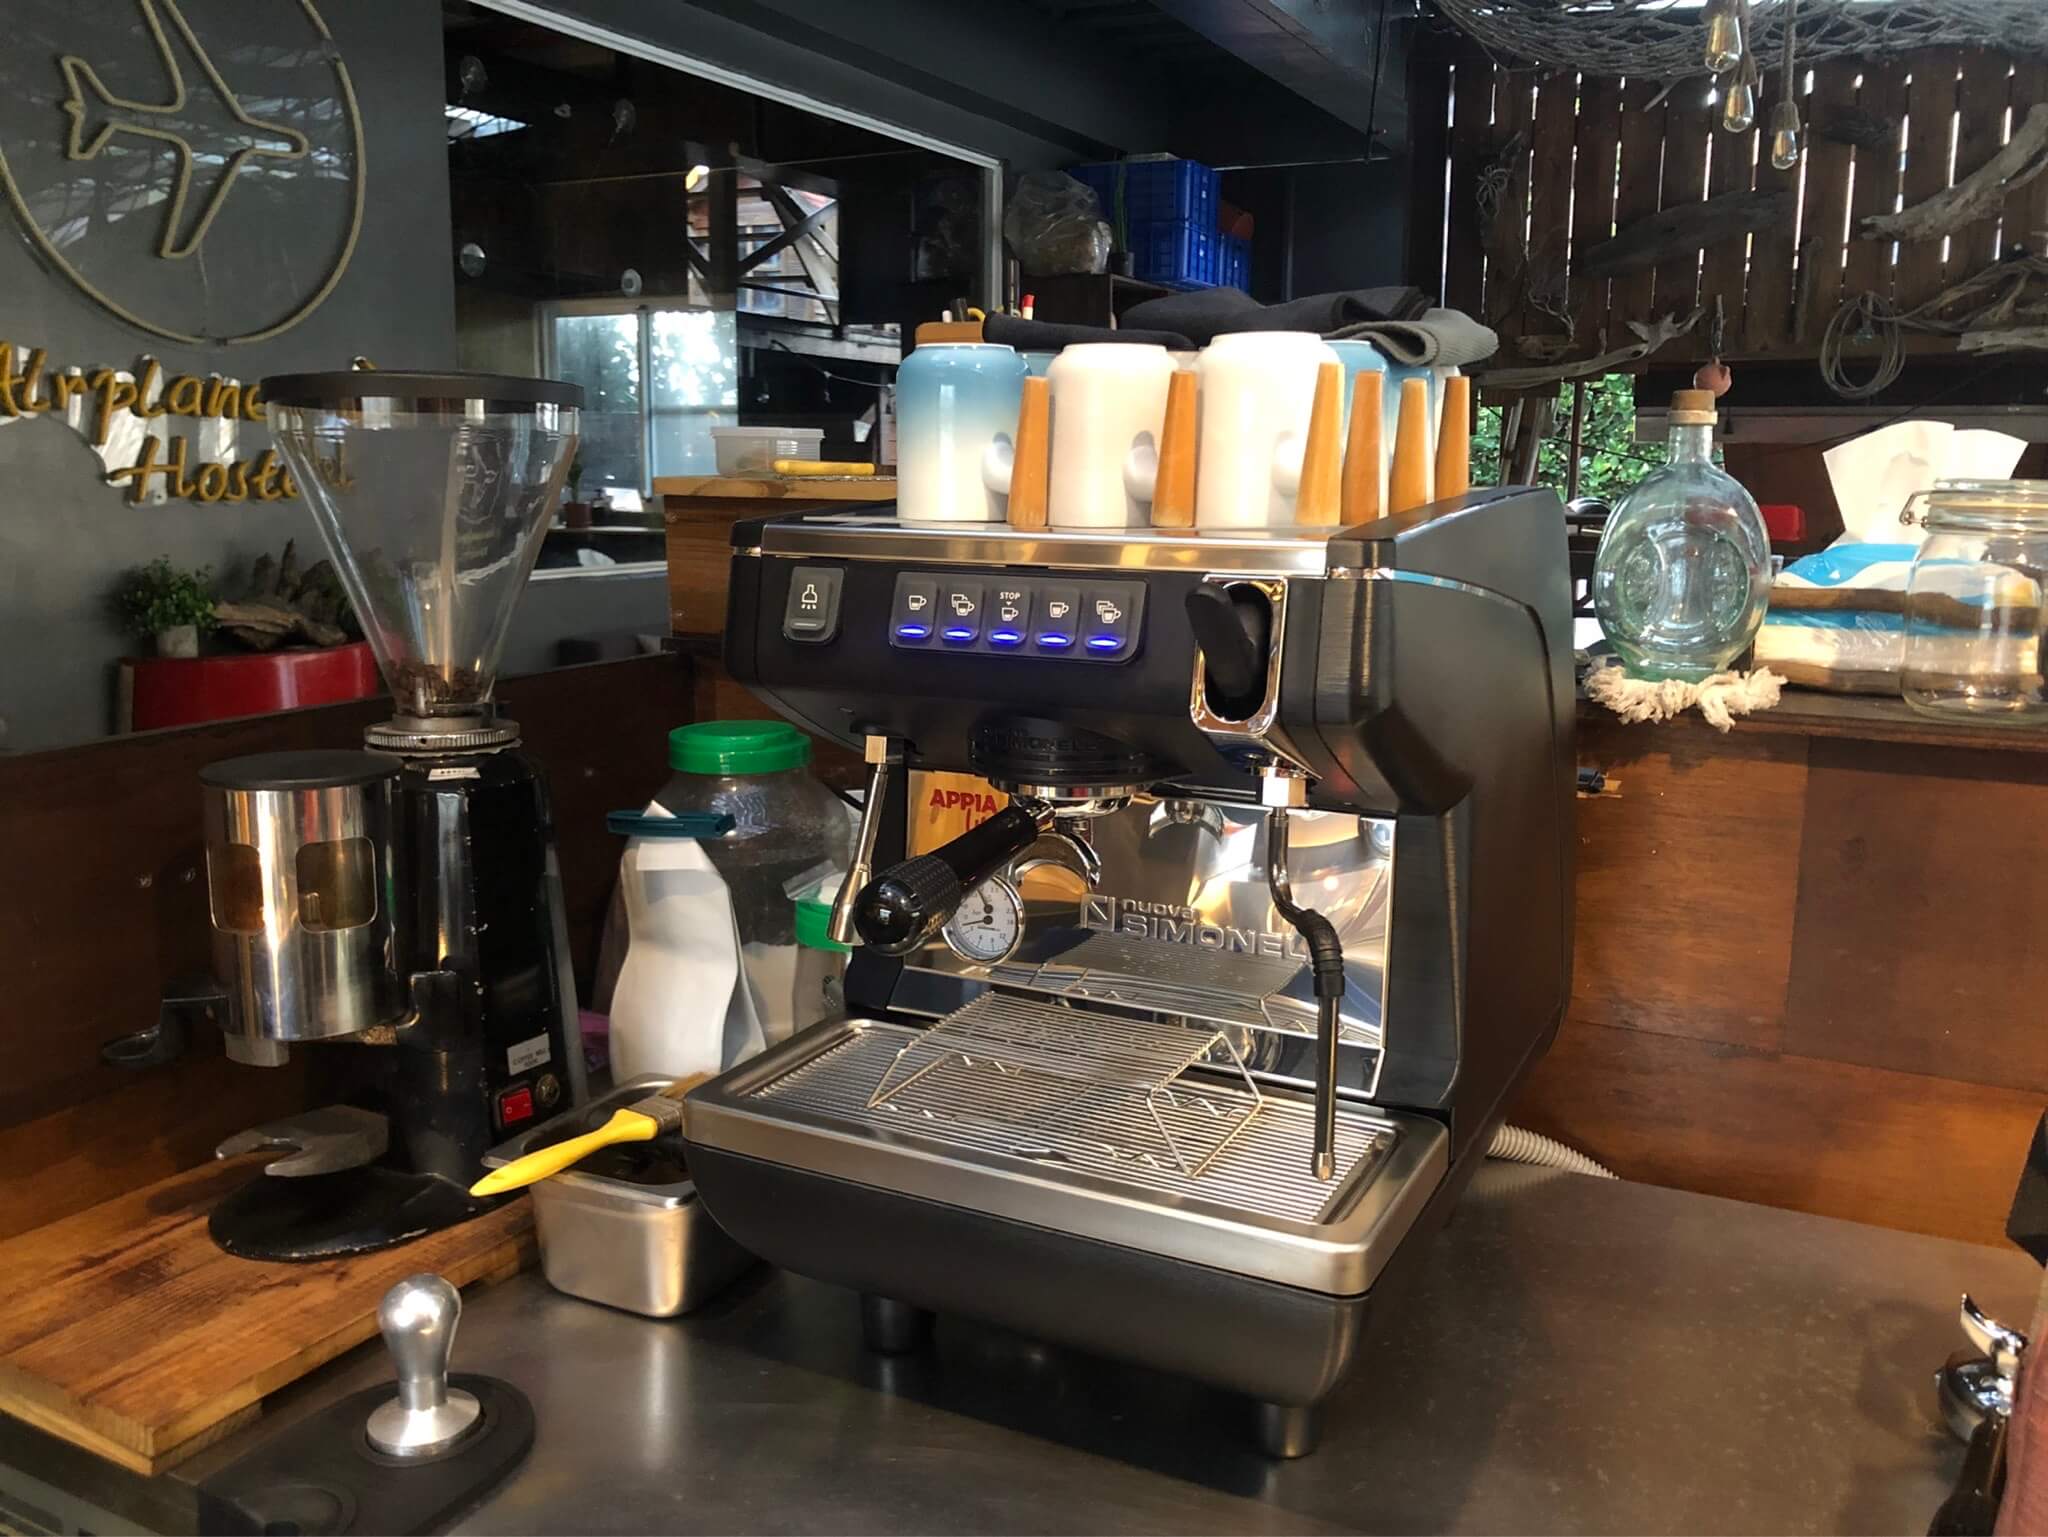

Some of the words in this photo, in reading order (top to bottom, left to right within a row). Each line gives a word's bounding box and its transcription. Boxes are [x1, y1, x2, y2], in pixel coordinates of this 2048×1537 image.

[999, 591, 1021, 600] STOP
[929, 788, 997, 813] APPIA
[1122, 912, 1309, 961] SIMONEL
